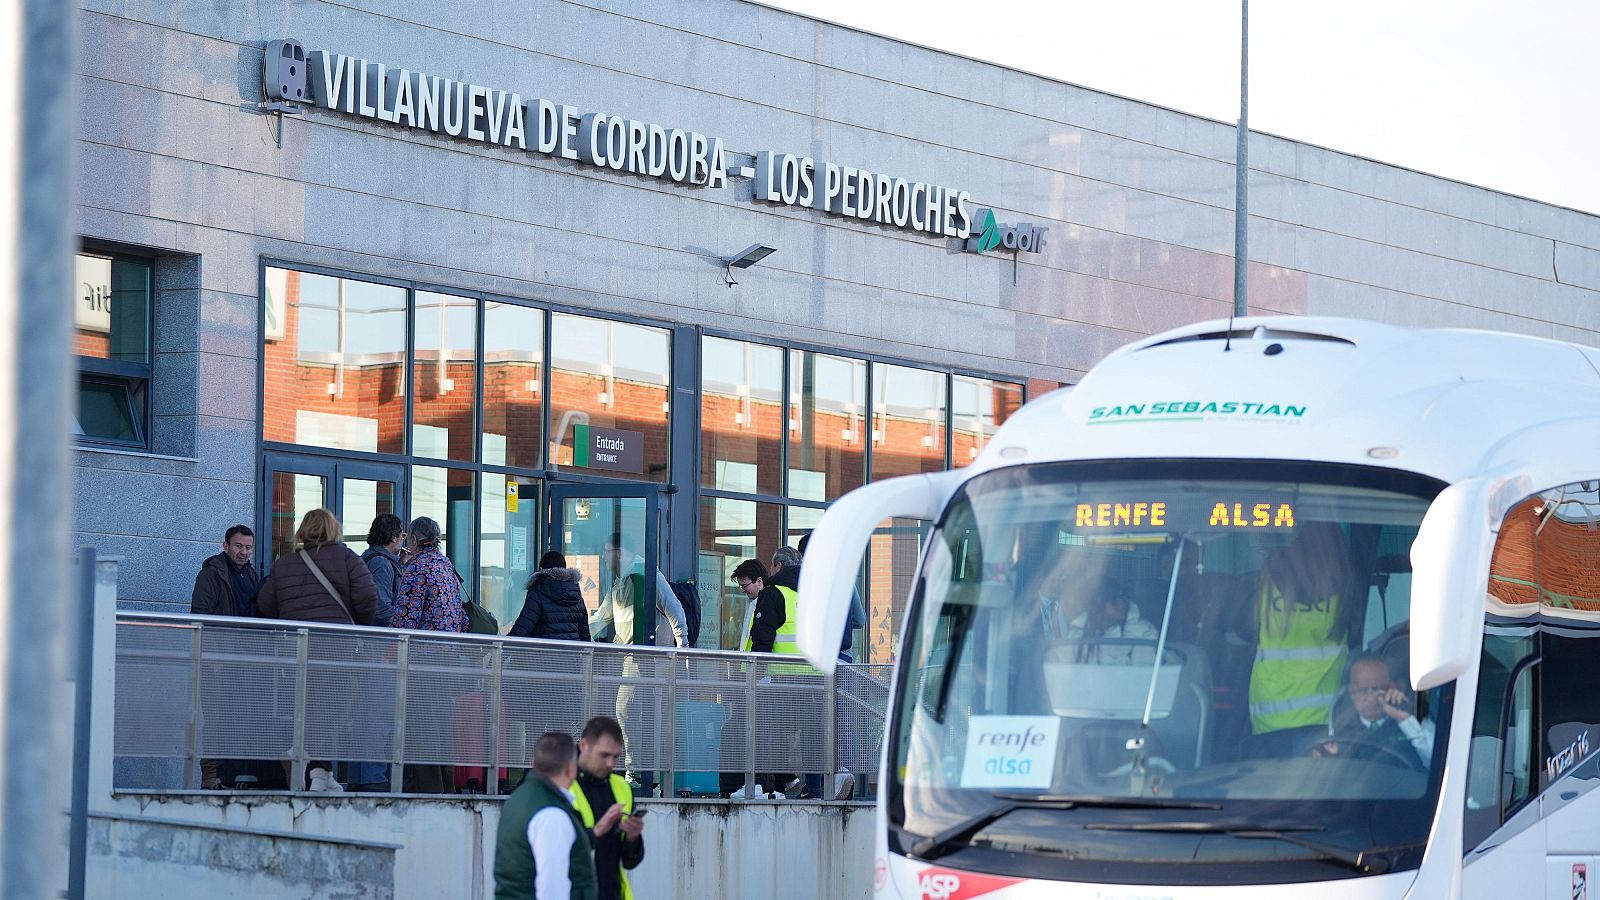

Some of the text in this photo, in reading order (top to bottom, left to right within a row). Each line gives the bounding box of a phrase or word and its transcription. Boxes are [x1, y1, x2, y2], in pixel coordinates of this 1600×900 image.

[321, 49, 527, 149] VILLANUEVA
[538, 98, 578, 160] DE
[590, 112, 728, 189] CORDOBA
[767, 150, 814, 208] LOS
[824, 162, 971, 239] PEDROCHES
[1002, 222, 1049, 255] adif
[1089, 401, 1308, 419] SAN SEBASTIAN
[596, 435, 625, 451] Entrada
[596, 452, 618, 463] ENTRANCE
[1076, 502, 1296, 528] RENFE ALSA
[978, 725, 1046, 753] renfe
[984, 753, 1032, 775] alsa
[919, 873, 961, 900] ASP
